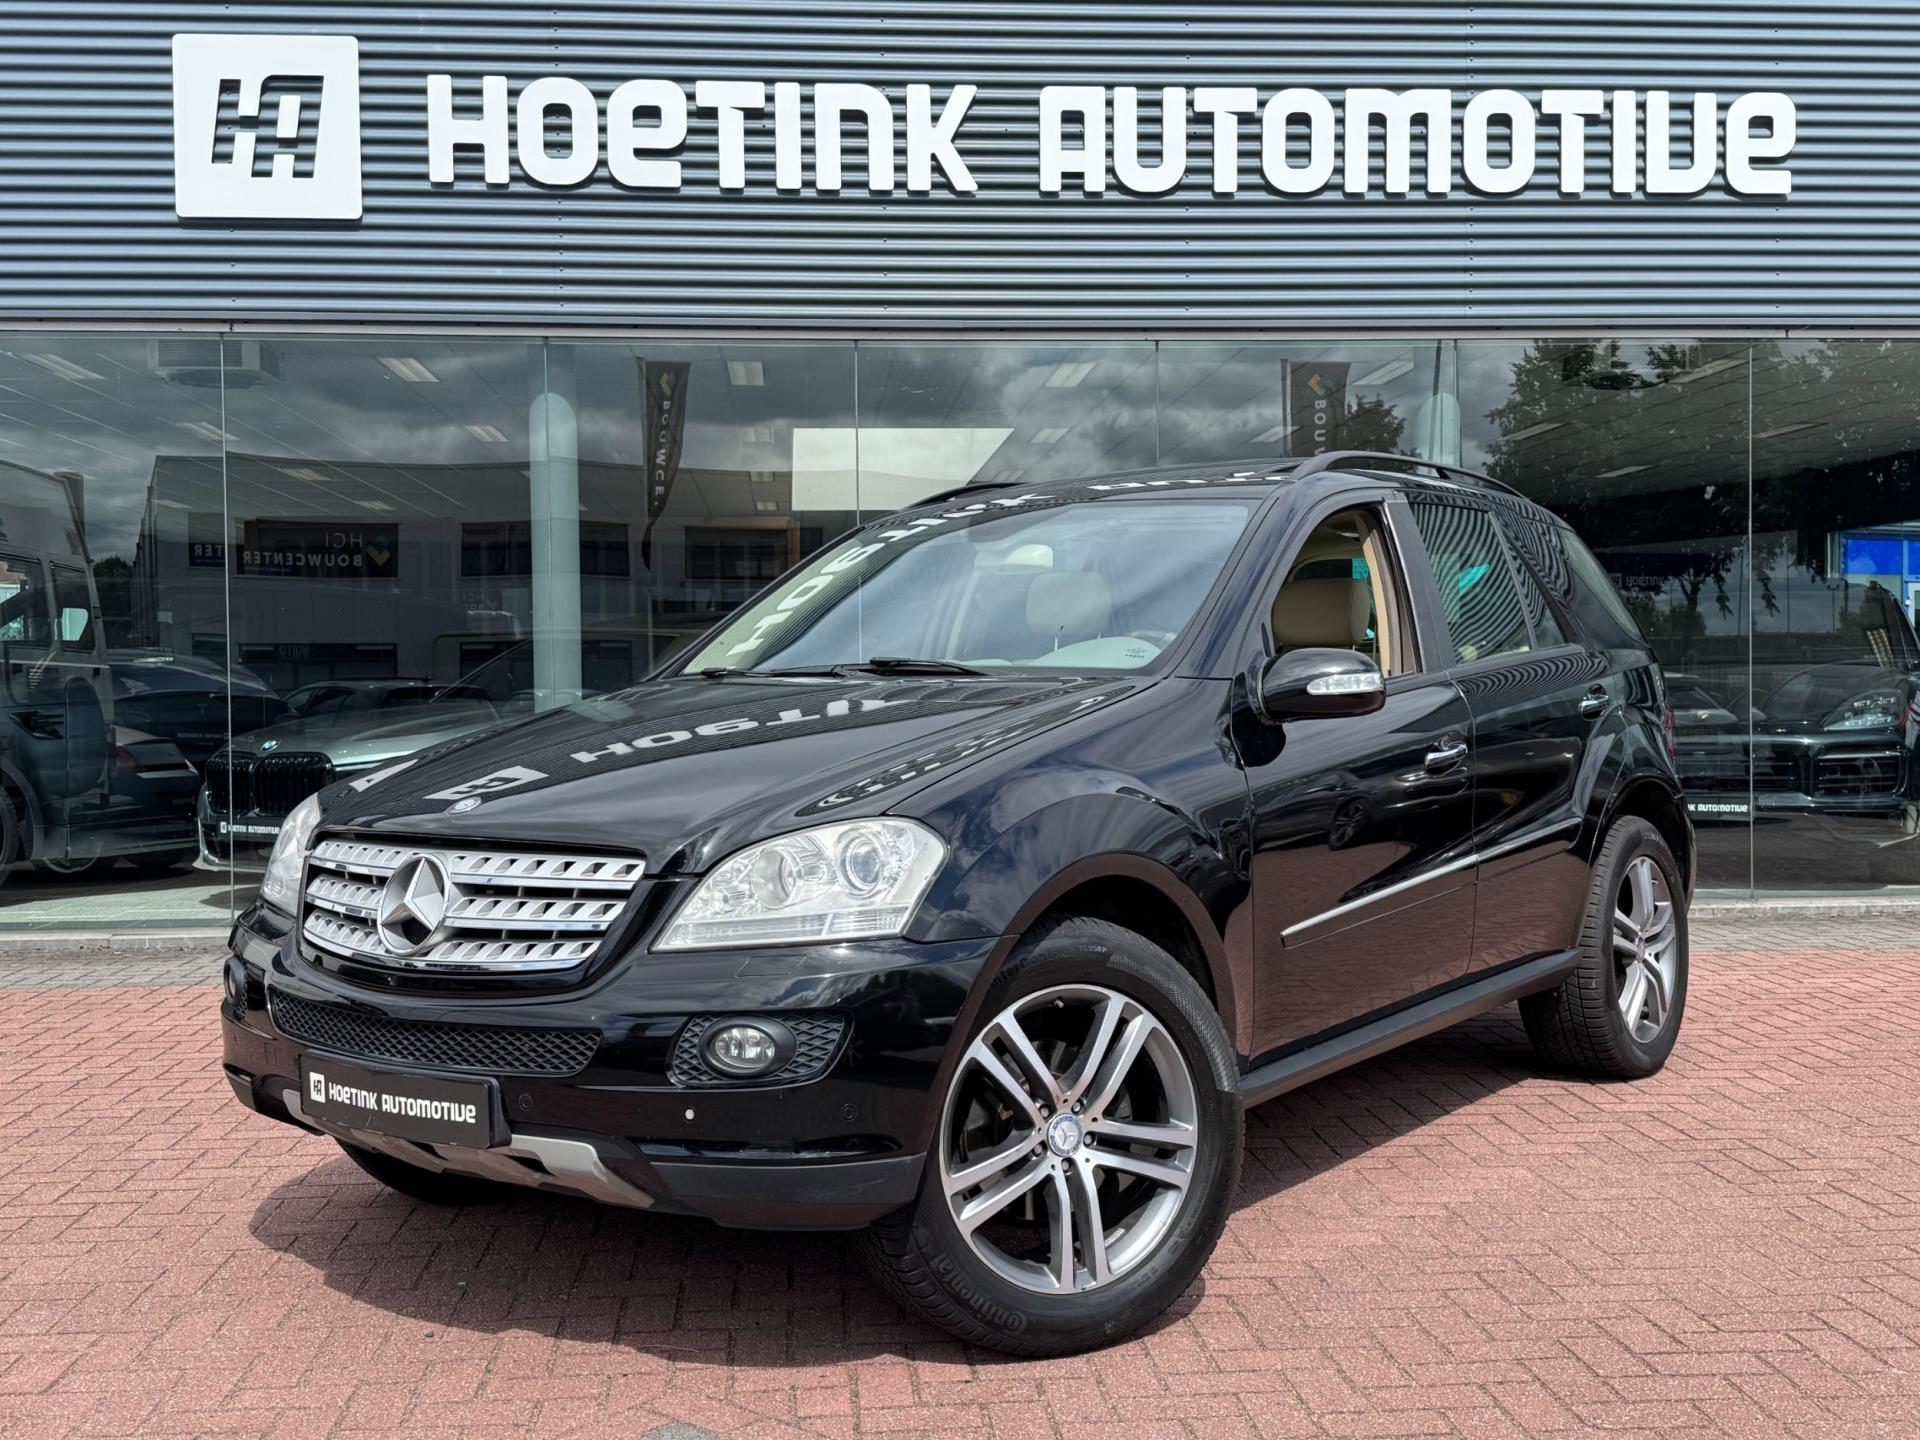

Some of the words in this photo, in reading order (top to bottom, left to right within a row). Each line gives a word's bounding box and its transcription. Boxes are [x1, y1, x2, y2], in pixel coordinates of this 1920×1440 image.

[426, 73, 979, 192] HOETINK
[1038, 85, 1797, 195] AUTOMOTIVE
[653, 400, 672, 507] BOUWCE
[1697, 803, 1749, 813] AUTOMOTIVE
[328, 1081, 379, 1111] HOETINK
[382, 1093, 477, 1124] AUTOMOTIVE
